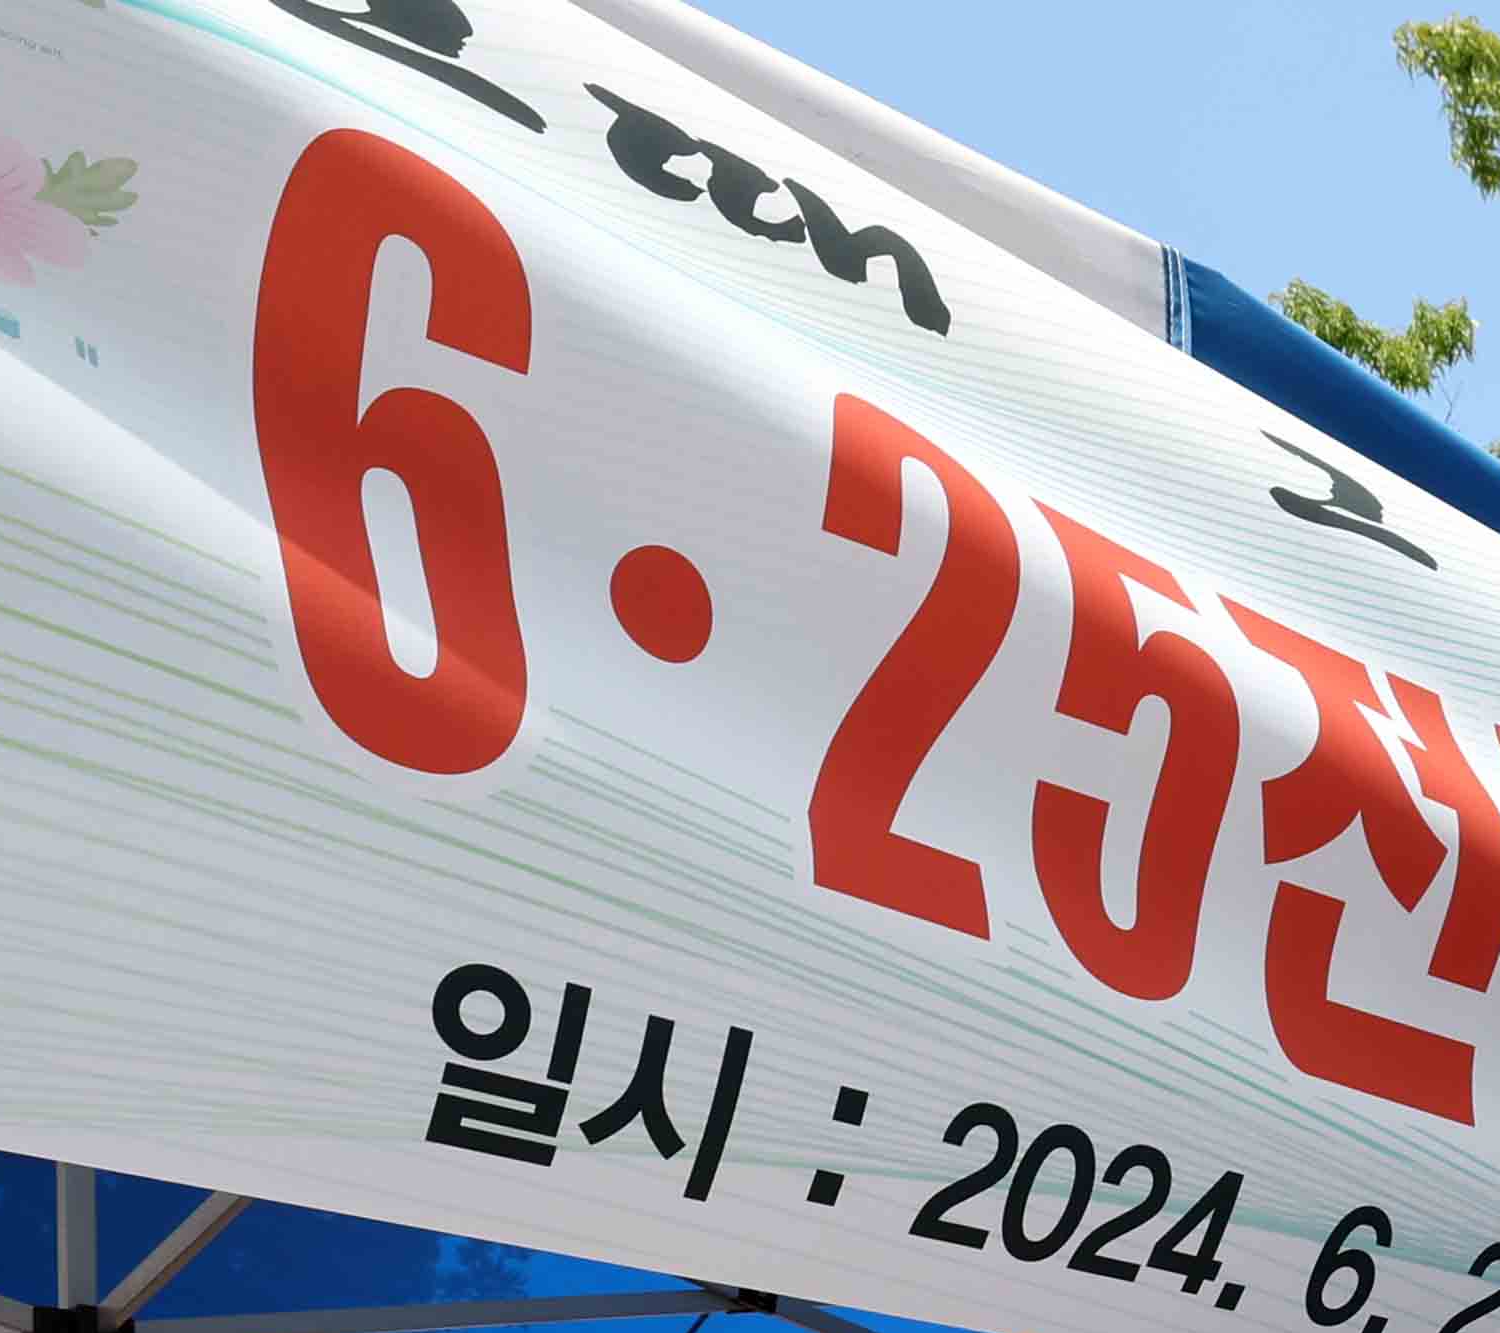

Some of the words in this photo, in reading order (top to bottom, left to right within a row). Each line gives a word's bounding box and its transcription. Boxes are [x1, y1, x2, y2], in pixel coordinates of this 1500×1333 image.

[1260, 429, 1438, 571] 그
[426, 963, 754, 1201] 일시
[908, 1100, 1247, 1312] 2024.
